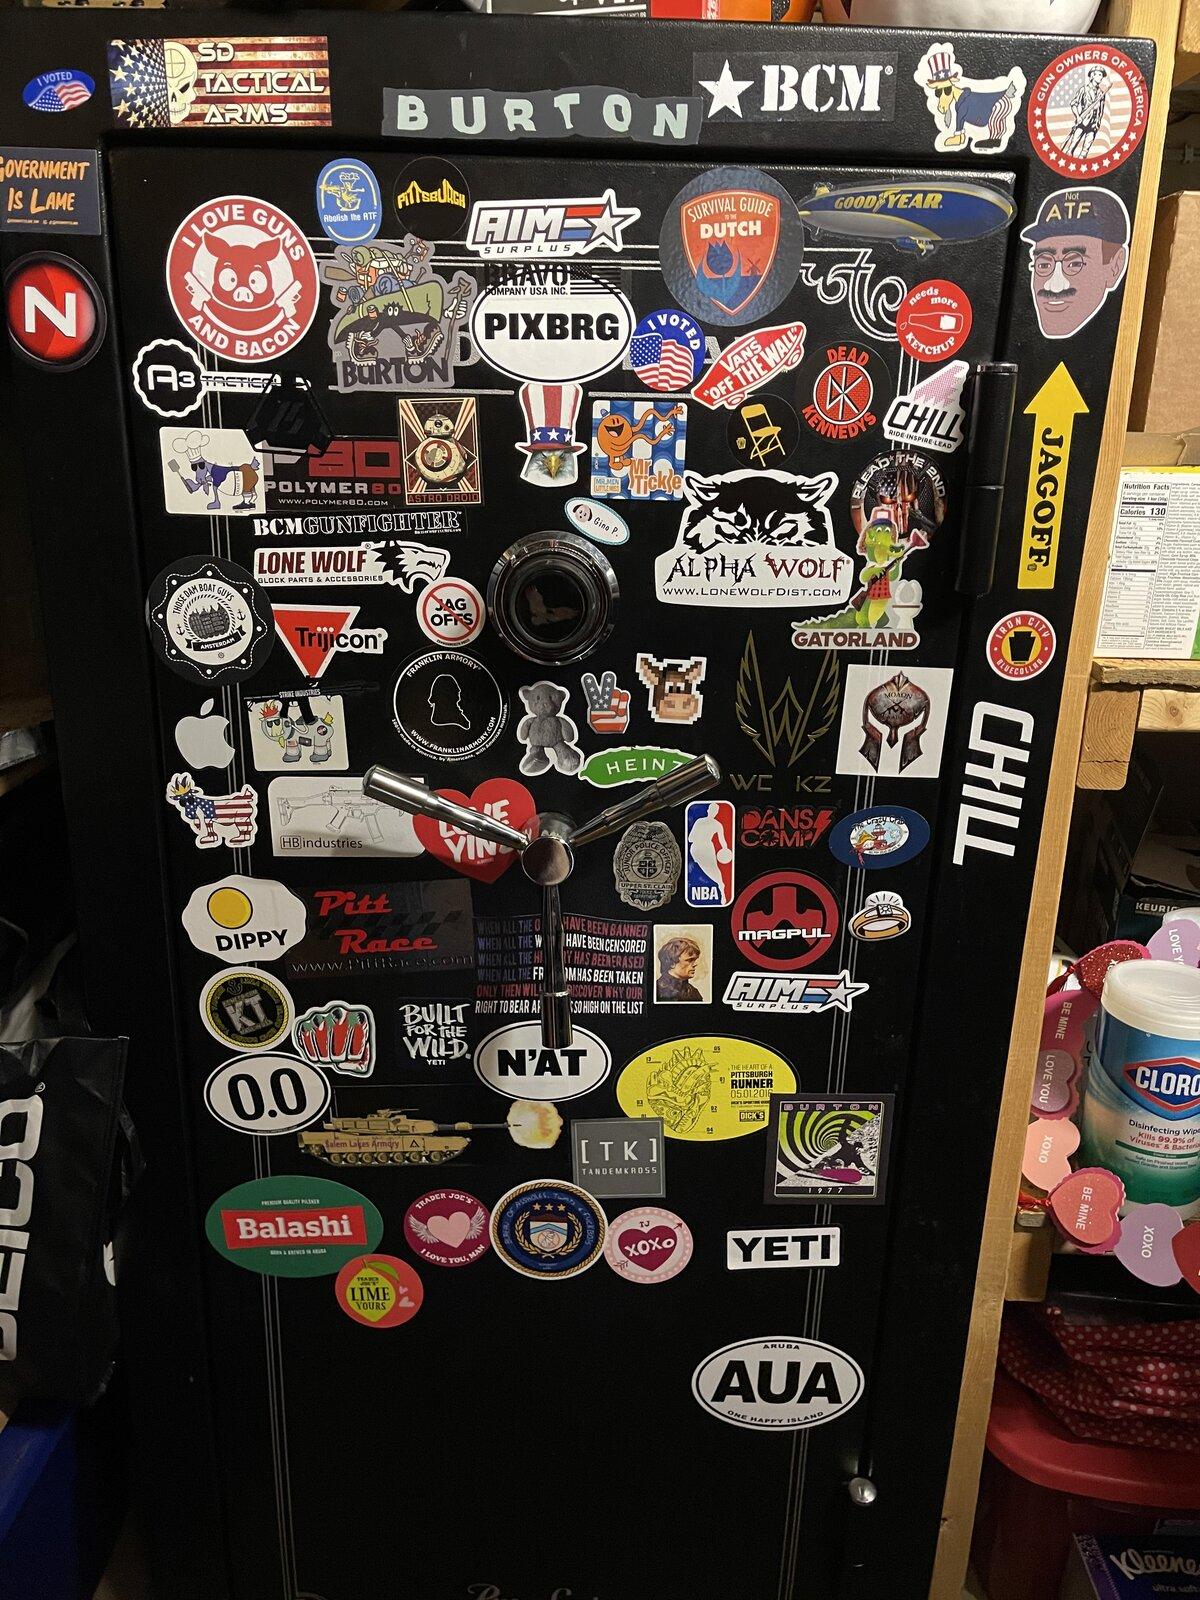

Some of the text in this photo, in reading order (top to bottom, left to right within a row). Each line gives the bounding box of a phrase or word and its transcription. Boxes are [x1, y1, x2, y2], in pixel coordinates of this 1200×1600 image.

[198, 42, 235, 62] SD
[45, 71, 73, 82] VOTED
[200, 72, 326, 94] TACTICAL
[1037, 50, 1144, 127] GUN OWNERS OF AMERICA
[203, 104, 289, 125] ARMS
[397, 93, 690, 139] BURTON
[0, 156, 91, 182] GOVERNMENT
[7, 188, 76, 215] IS LAME
[397, 179, 467, 210] PITTSBURGH
[834, 190, 943, 212] GOODYEAR
[1065, 191, 1081, 201] Not
[324, 211, 378, 223] Abolish ATF
[687, 196, 775, 223] SURVIVAL GUIDE
[1046, 200, 1092, 223] ATF
[191, 203, 306, 262] LOVE GUNS
[478, 204, 566, 244] AIM
[699, 219, 763, 240] DUTCH
[484, 244, 572, 256] SURPLUS
[530, 286, 569, 297] USA INC.
[909, 286, 939, 306] needs
[24, 285, 77, 339] N
[930, 297, 958, 309] more
[187, 318, 302, 357] AND BACON
[484, 313, 620, 341] PIXBRG
[658, 312, 701, 350] VOTED
[905, 331, 955, 355] KETCHUP
[721, 339, 762, 373] VANS
[826, 346, 870, 370] DEAD
[342, 357, 450, 387] BURTON
[801, 404, 877, 440] KENNEDYS
[265, 481, 402, 495] POLYMER80
[633, 471, 682, 494] Tickle
[925, 466, 946, 498] 2ND
[408, 493, 479, 503] ASTRO DROID
[1028, 426, 1064, 568] JAGOFF
[1120, 507, 1166, 516] Calories 130
[258, 549, 368, 576] LONE WOLF
[663, 552, 846, 586] ALPHA WOLF
[258, 575, 384, 584] GLOCK PARTS ACCESSORIES
[172, 583, 235, 615] THOSE DAM BOAT GUYS
[435, 598, 467, 612] JAG
[430, 613, 474, 627] OFFS
[994, 616, 1051, 640] IRON CITY
[200, 637, 236, 650] AMSTERDAM
[295, 625, 378, 652] Trijicon
[794, 631, 918, 648] GATORLAND
[406, 653, 479, 678] FRANKLIN ARMORY
[996, 656, 1046, 676] BLUECOLLAR
[411, 716, 497, 754] WWW.FRANKLINARMORY.COM
[622, 841, 672, 875] JUNIOR POLICE OFFICER
[314, 890, 393, 917] Pitt
[691, 886, 719, 900] NBA
[519, 920, 648, 937] THE BEEN BANNED
[738, 927, 831, 941] MAGPUL
[214, 928, 289, 952] DIPPY
[335, 928, 438, 955] Race
[566, 934, 647, 953] HAVE BEEN CENSORED
[574, 952, 645, 969] HAS ERASED
[578, 968, 644, 985] HAS BEEN TAKEN
[476, 984, 643, 1000] ONLY THEN WHY OUR
[731, 977, 806, 1001] AIM
[399, 1003, 470, 1026] BUILT
[475, 1000, 644, 1015] RIGHT TO BEAR SO HIGH ON THE LIST
[736, 1001, 810, 1011] SURPLUS
[407, 1025, 467, 1037] FOR THE
[1055, 1002, 1072, 1040] BE MINE
[402, 1036, 472, 1060] WILD.
[498, 1049, 587, 1076] N'AT
[730, 1078, 774, 1089] RUNNER
[1039, 1055, 1055, 1103] LOVE YOU
[227, 1067, 307, 1121] 0.0
[783, 1103, 879, 1111] BURTON
[1129, 1119, 1181, 1137] Disinfecting
[1138, 1131, 1185, 1144] Kills 99.9%
[325, 1140, 347, 1148] Salem
[349, 1140, 369, 1148] Lakes
[1038, 1135, 1054, 1164] XOXO
[581, 1166, 658, 1175] TANDEMKROSS
[415, 1192, 474, 1209] TRADER JOE'S
[807, 1186, 843, 1194] 1977
[1075, 1186, 1093, 1231] BE MINE
[235, 1214, 353, 1240] Balashi
[624, 1237, 676, 1258] XOXO
[731, 1234, 832, 1263] YETI
[1141, 1225, 1155, 1259] XOXO
[427, 1244, 486, 1265] LOVE YOU, MAN
[350, 1286, 391, 1302] LIME
[355, 1301, 387, 1311] YOURS
[762, 1343, 801, 1351] ARUBA
[710, 1359, 843, 1405] AUA
[727, 1409, 824, 1424] ONE HAPPY ISLAND
